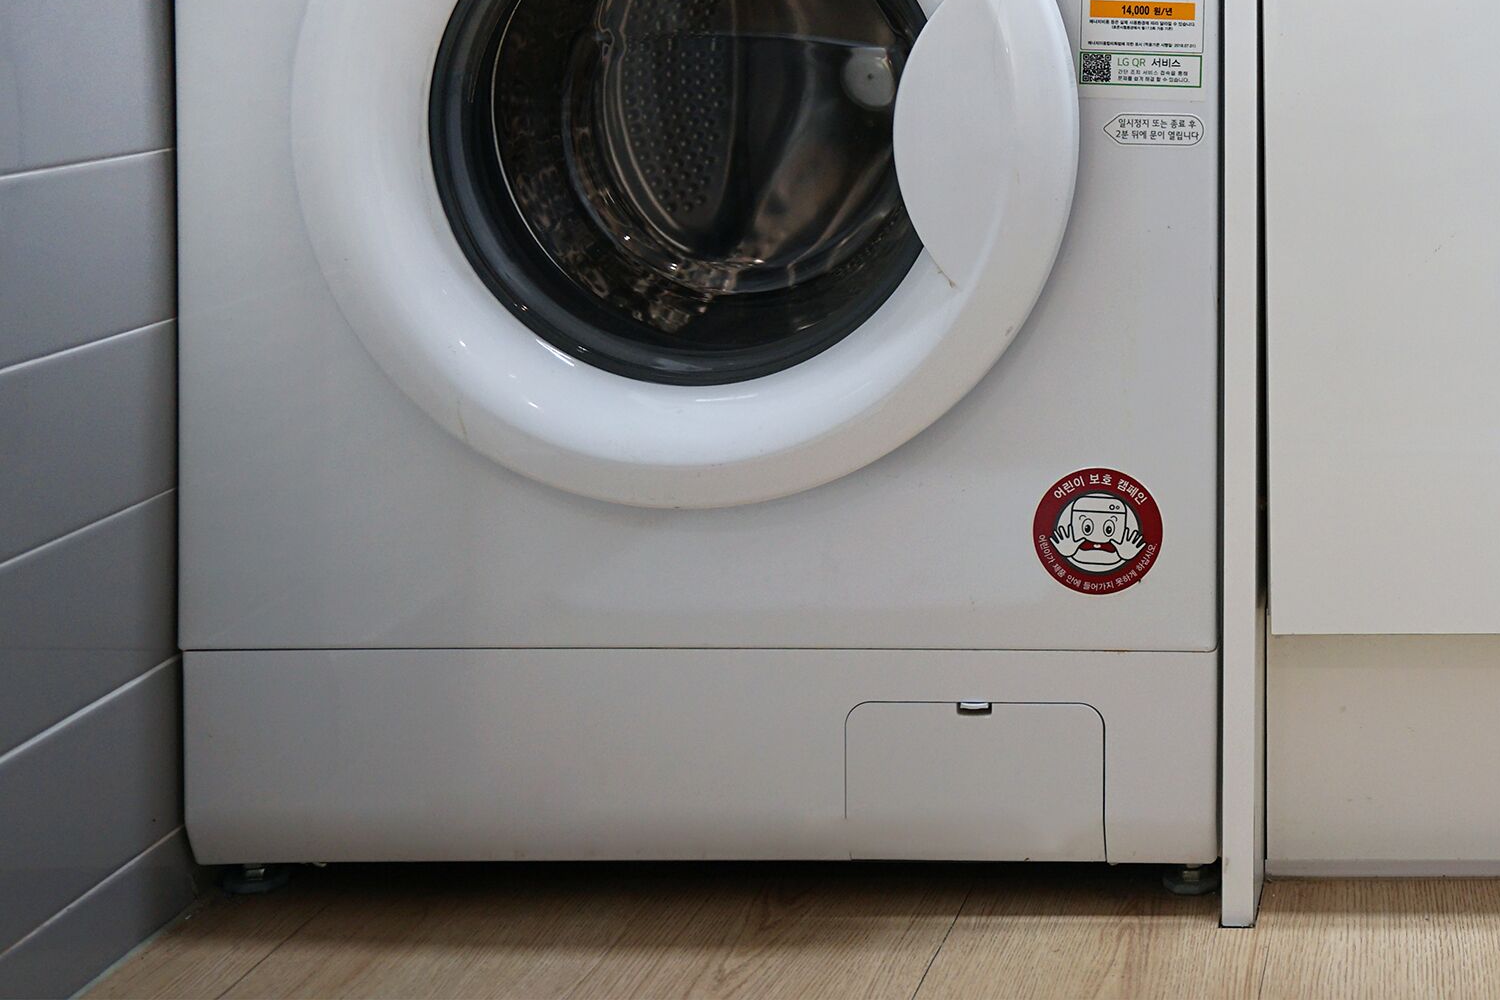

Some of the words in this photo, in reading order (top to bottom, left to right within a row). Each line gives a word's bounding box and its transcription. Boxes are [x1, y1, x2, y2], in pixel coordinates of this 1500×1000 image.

[1121, 5, 1150, 16] 14,000
[1154, 6, 1172, 16] 원/년
[1117, 58, 1129, 66] LG
[1132, 58, 1145, 68] QR
[1151, 58, 1181, 68] 서비스
[1118, 118, 1150, 128] 일시정지
[1152, 119, 1167, 128] 또는
[1170, 120, 1185, 129] 종료
[1188, 120, 1196, 129] 후
[1116, 130, 1128, 139] 2분
[1131, 130, 1147, 139] 뒤에
[1150, 130, 1165, 140] 문이
[1168, 130, 1199, 141] 열립니다
[1054, 476, 1085, 499] 어린이
[1089, 474, 1112, 485] 보호
[1117, 479, 1148, 505] 캠페인
[1039, 534, 1055, 564] 어린이가
[1066, 575, 1080, 587] 안에
[1083, 582, 1114, 591] 들어가지
[1116, 571, 1138, 587] 못하게
